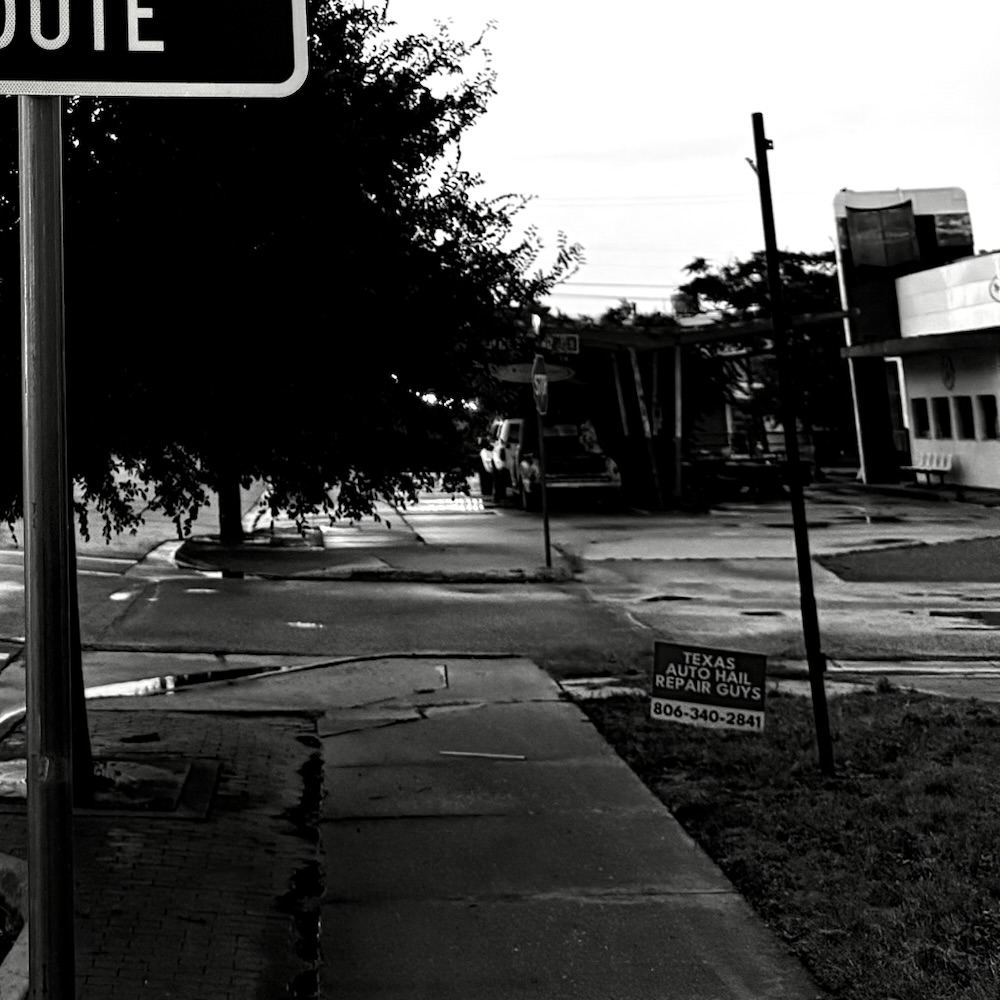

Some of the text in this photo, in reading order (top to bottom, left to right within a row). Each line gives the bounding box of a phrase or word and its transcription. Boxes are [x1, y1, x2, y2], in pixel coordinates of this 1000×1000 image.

[682, 651, 736, 670] TEXAS
[665, 663, 752, 686] AUTO HAIL
[655, 674, 762, 701] REPAIR GUYS
[653, 702, 761, 728] 806-340-2841
